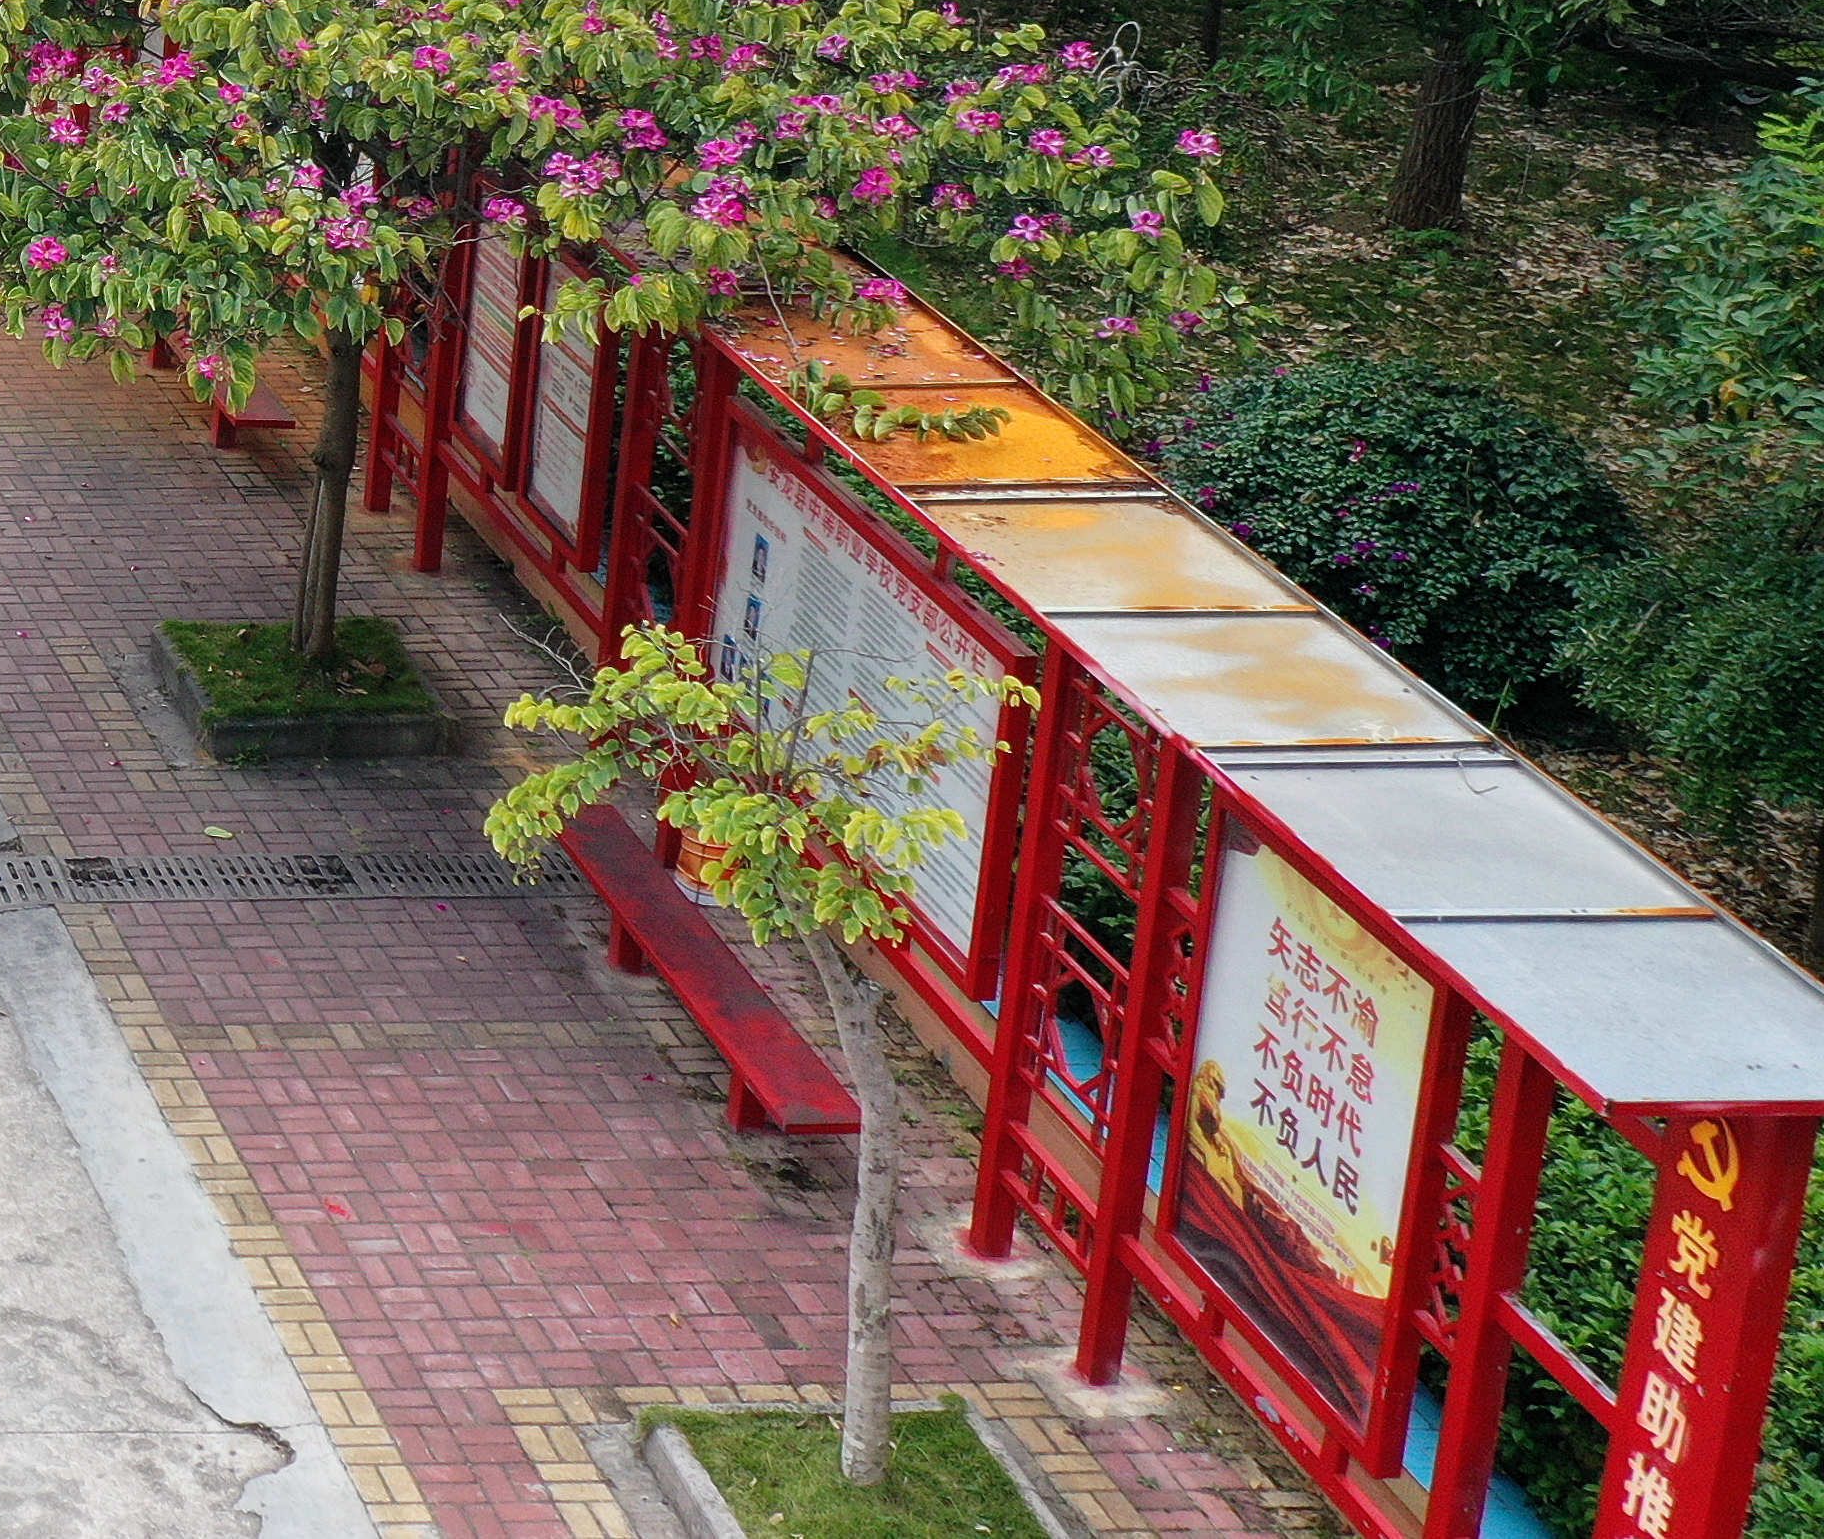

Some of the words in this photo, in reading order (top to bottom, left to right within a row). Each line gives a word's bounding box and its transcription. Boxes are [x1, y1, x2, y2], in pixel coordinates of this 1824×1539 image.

[1266, 916, 1379, 1048] 矢志不渝
[1250, 1077, 1359, 1216] 不负人民
[1253, 1024, 1363, 1158] 不负时代
[1622, 1209, 1719, 1539] 党建助推
